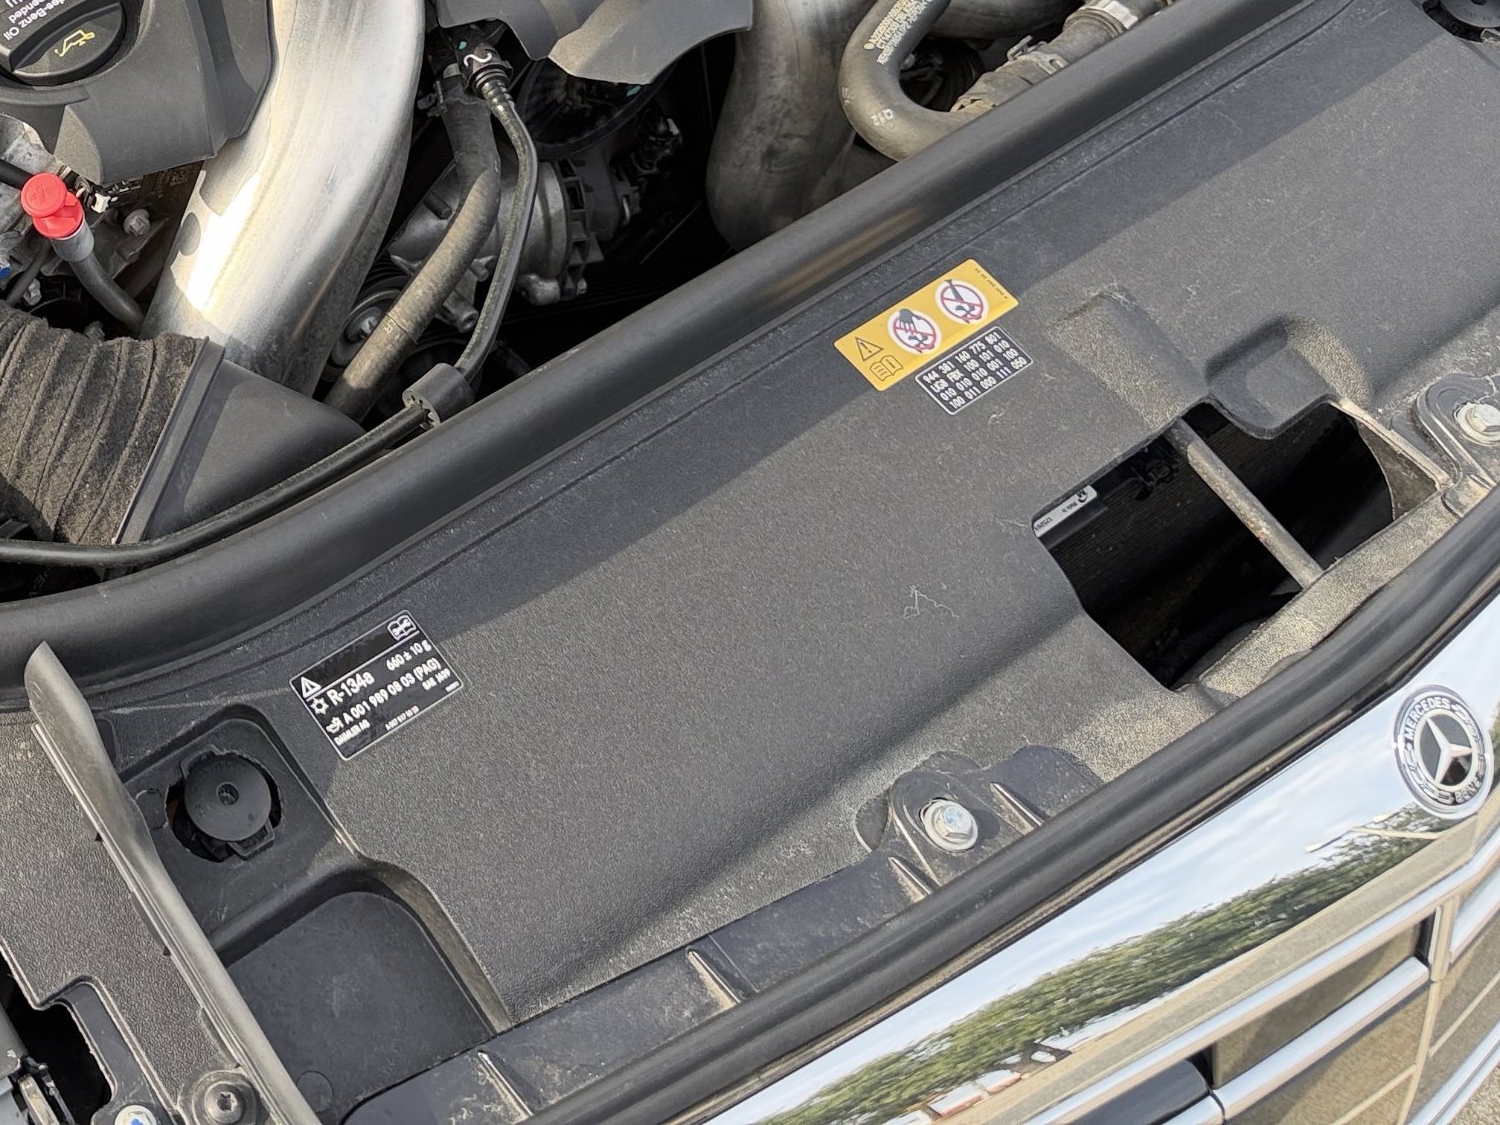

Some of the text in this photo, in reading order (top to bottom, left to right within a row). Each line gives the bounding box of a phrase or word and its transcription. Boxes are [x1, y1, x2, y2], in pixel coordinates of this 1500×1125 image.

[2, 26, 20, 41] Oil
[922, 370, 940, 384] 944
[955, 350, 971, 363] 160
[969, 341, 986, 354] 775
[940, 348, 1018, 401] 010 010 010 001 100
[963, 359, 979, 372] 100
[979, 350, 995, 362] 101
[993, 340, 1010, 353] 010
[949, 396, 965, 409] 100
[964, 386, 981, 399] 011
[980, 376, 997, 389] 000
[996, 366, 1012, 379] 111
[327, 671, 375, 706] R-134a
[386, 653, 405, 671] 660
[410, 642, 423, 655] 10
[421, 639, 432, 652] g
[342, 657, 442, 725] A 001 989 08 03 (PAG)
[334, 719, 371, 746] DAIMLER AG
[1404, 696, 1451, 741] MERCEDES
